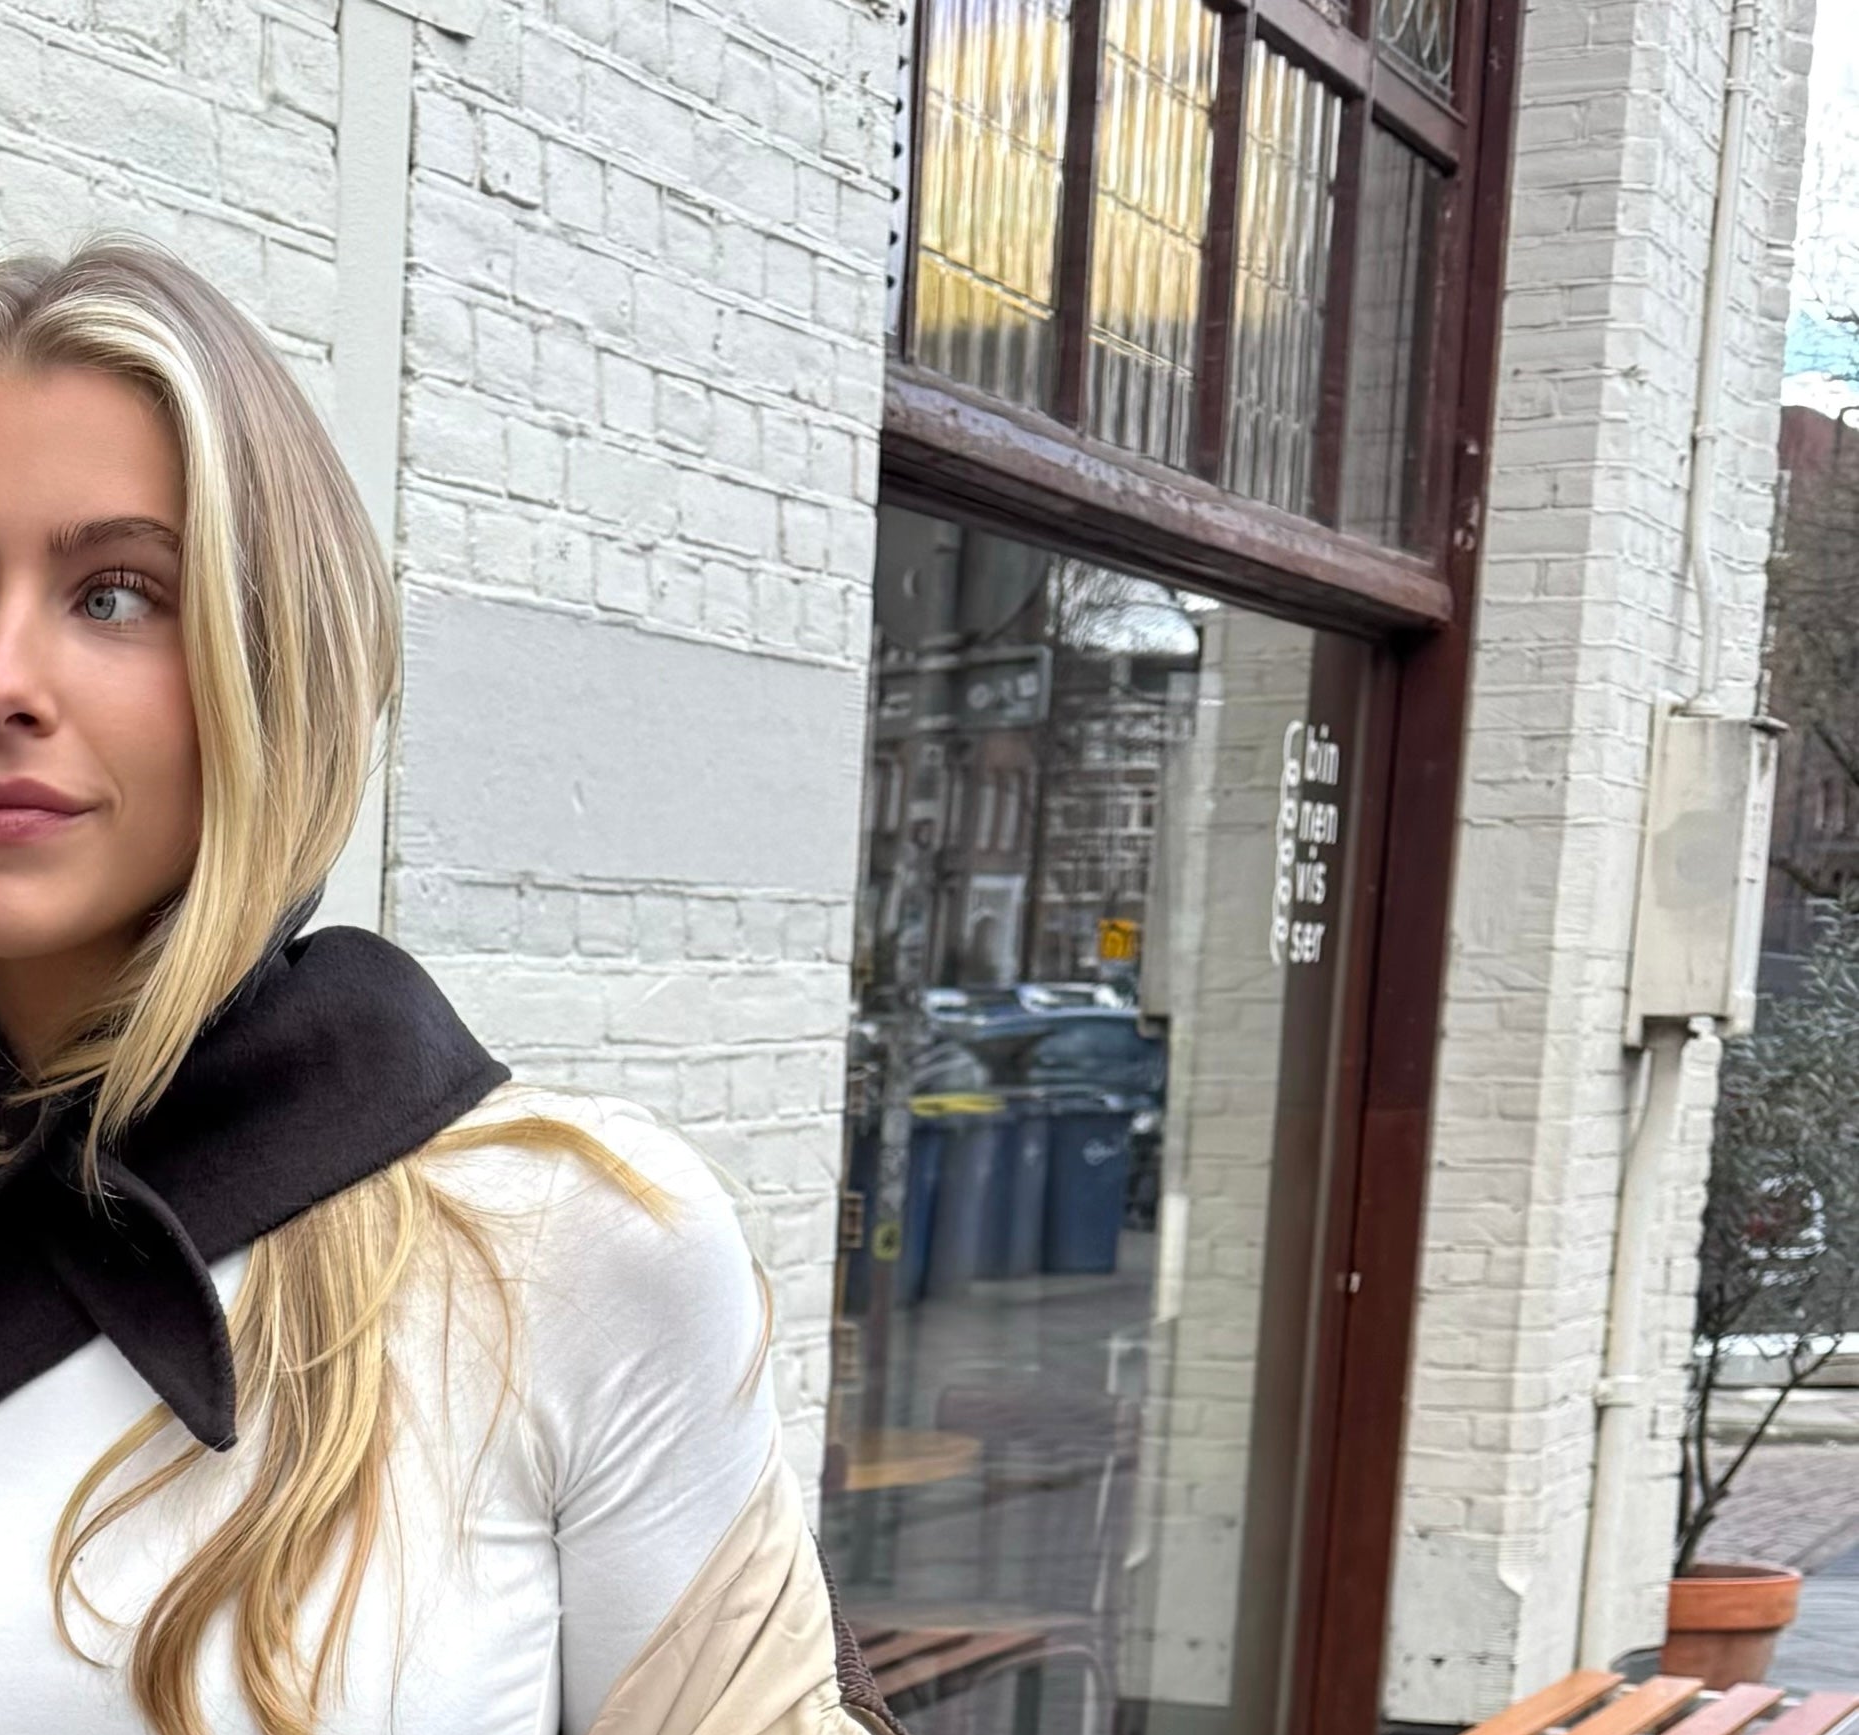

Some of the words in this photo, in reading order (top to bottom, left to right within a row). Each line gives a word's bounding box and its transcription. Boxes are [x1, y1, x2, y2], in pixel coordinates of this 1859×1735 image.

[1306, 724, 1339, 784] bin
[1299, 801, 1338, 845] nen
[1295, 846, 1327, 904] vis
[1290, 921, 1325, 963] ser
